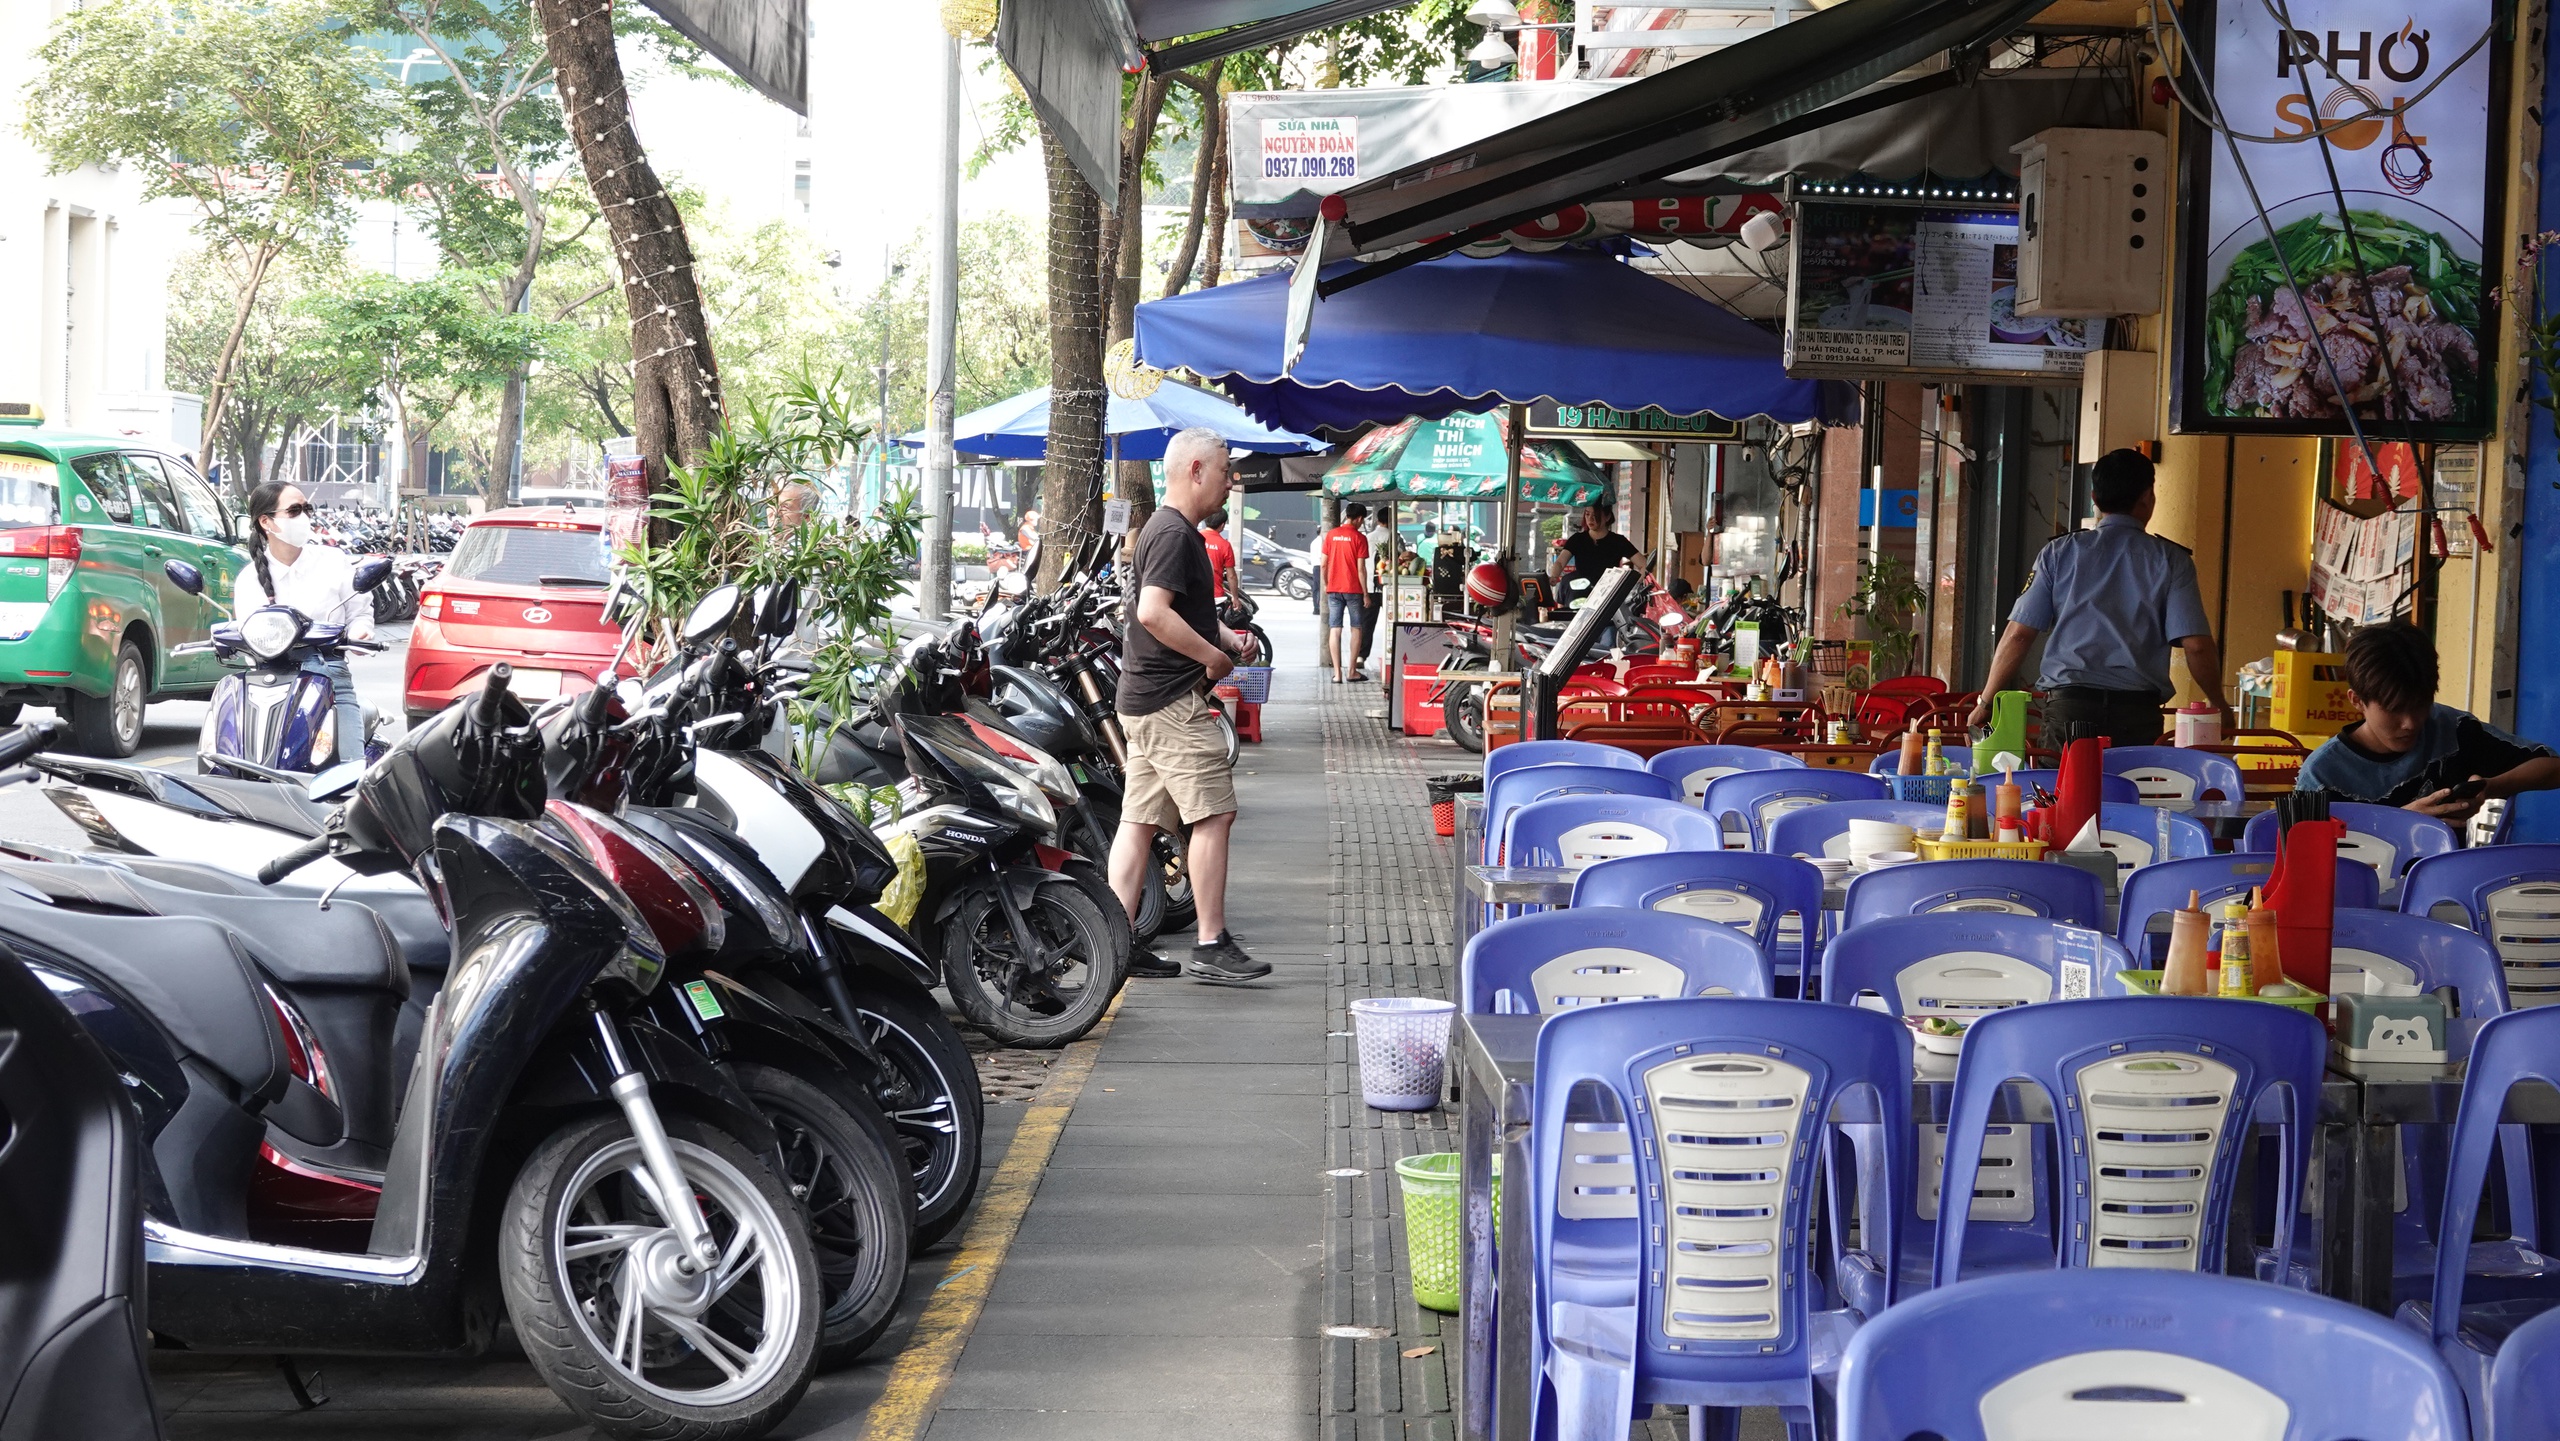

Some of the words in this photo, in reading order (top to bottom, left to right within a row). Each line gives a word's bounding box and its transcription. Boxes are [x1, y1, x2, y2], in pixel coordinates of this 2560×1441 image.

[1278, 118, 1306, 131] SỬA
[1311, 119, 1339, 131] NHÀ
[1320, 132, 1354, 153] ĐOÀN
[1265, 156, 1355, 178] 0937.090.268
[1890, 334, 1906, 347] TRIEU
[1440, 417, 1485, 429] THÍCH
[1557, 406, 1583, 427] 19
[1435, 429, 1464, 442] THÌ
[1433, 443, 1483, 457] NHÍCH
[2306, 709, 2365, 722] HABECO
[946, 829, 987, 844] HONDA
